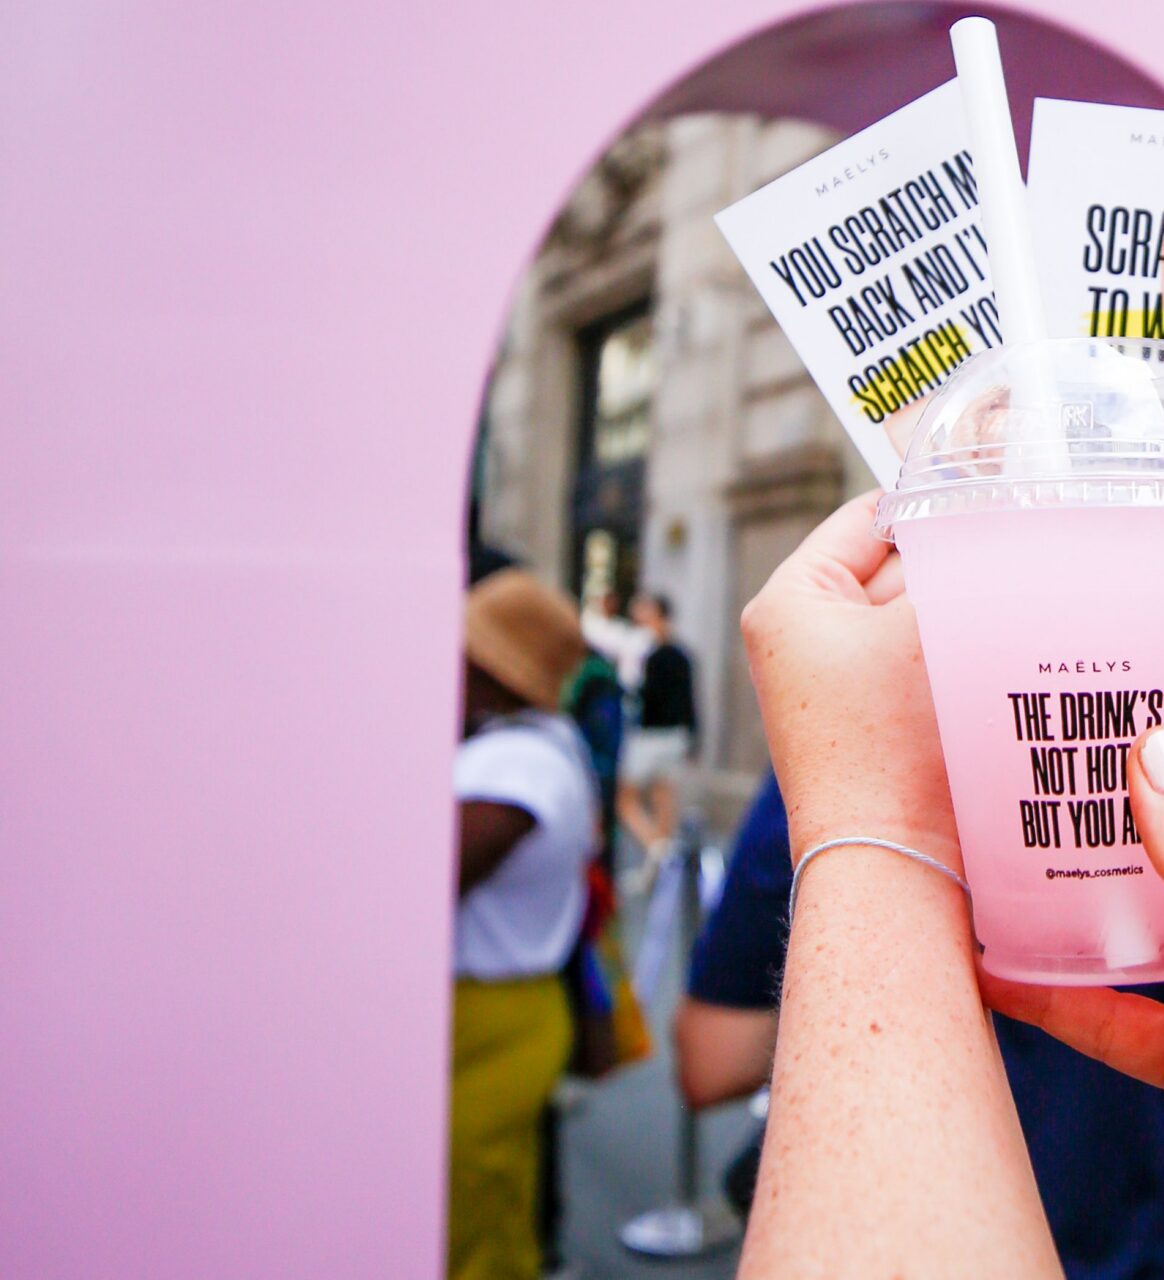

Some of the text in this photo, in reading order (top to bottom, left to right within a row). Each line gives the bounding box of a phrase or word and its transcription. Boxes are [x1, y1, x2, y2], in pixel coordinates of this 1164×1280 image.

[768, 236, 843, 308] YOU
[827, 169, 958, 276] SCRATCH
[826, 273, 916, 357] BACK
[900, 243, 970, 316] AND
[1086, 285, 1131, 339] TO
[846, 290, 1004, 425] SCRATCH YO
[1038, 659, 1132, 674] MAËLYS
[1007, 692, 1056, 742] THE
[1029, 742, 1132, 796] NOT HOT
[1019, 799, 1062, 849] BUT
[1067, 797, 1117, 849] YOU
[1045, 863, 1144, 880] @maelys_cosmetics
